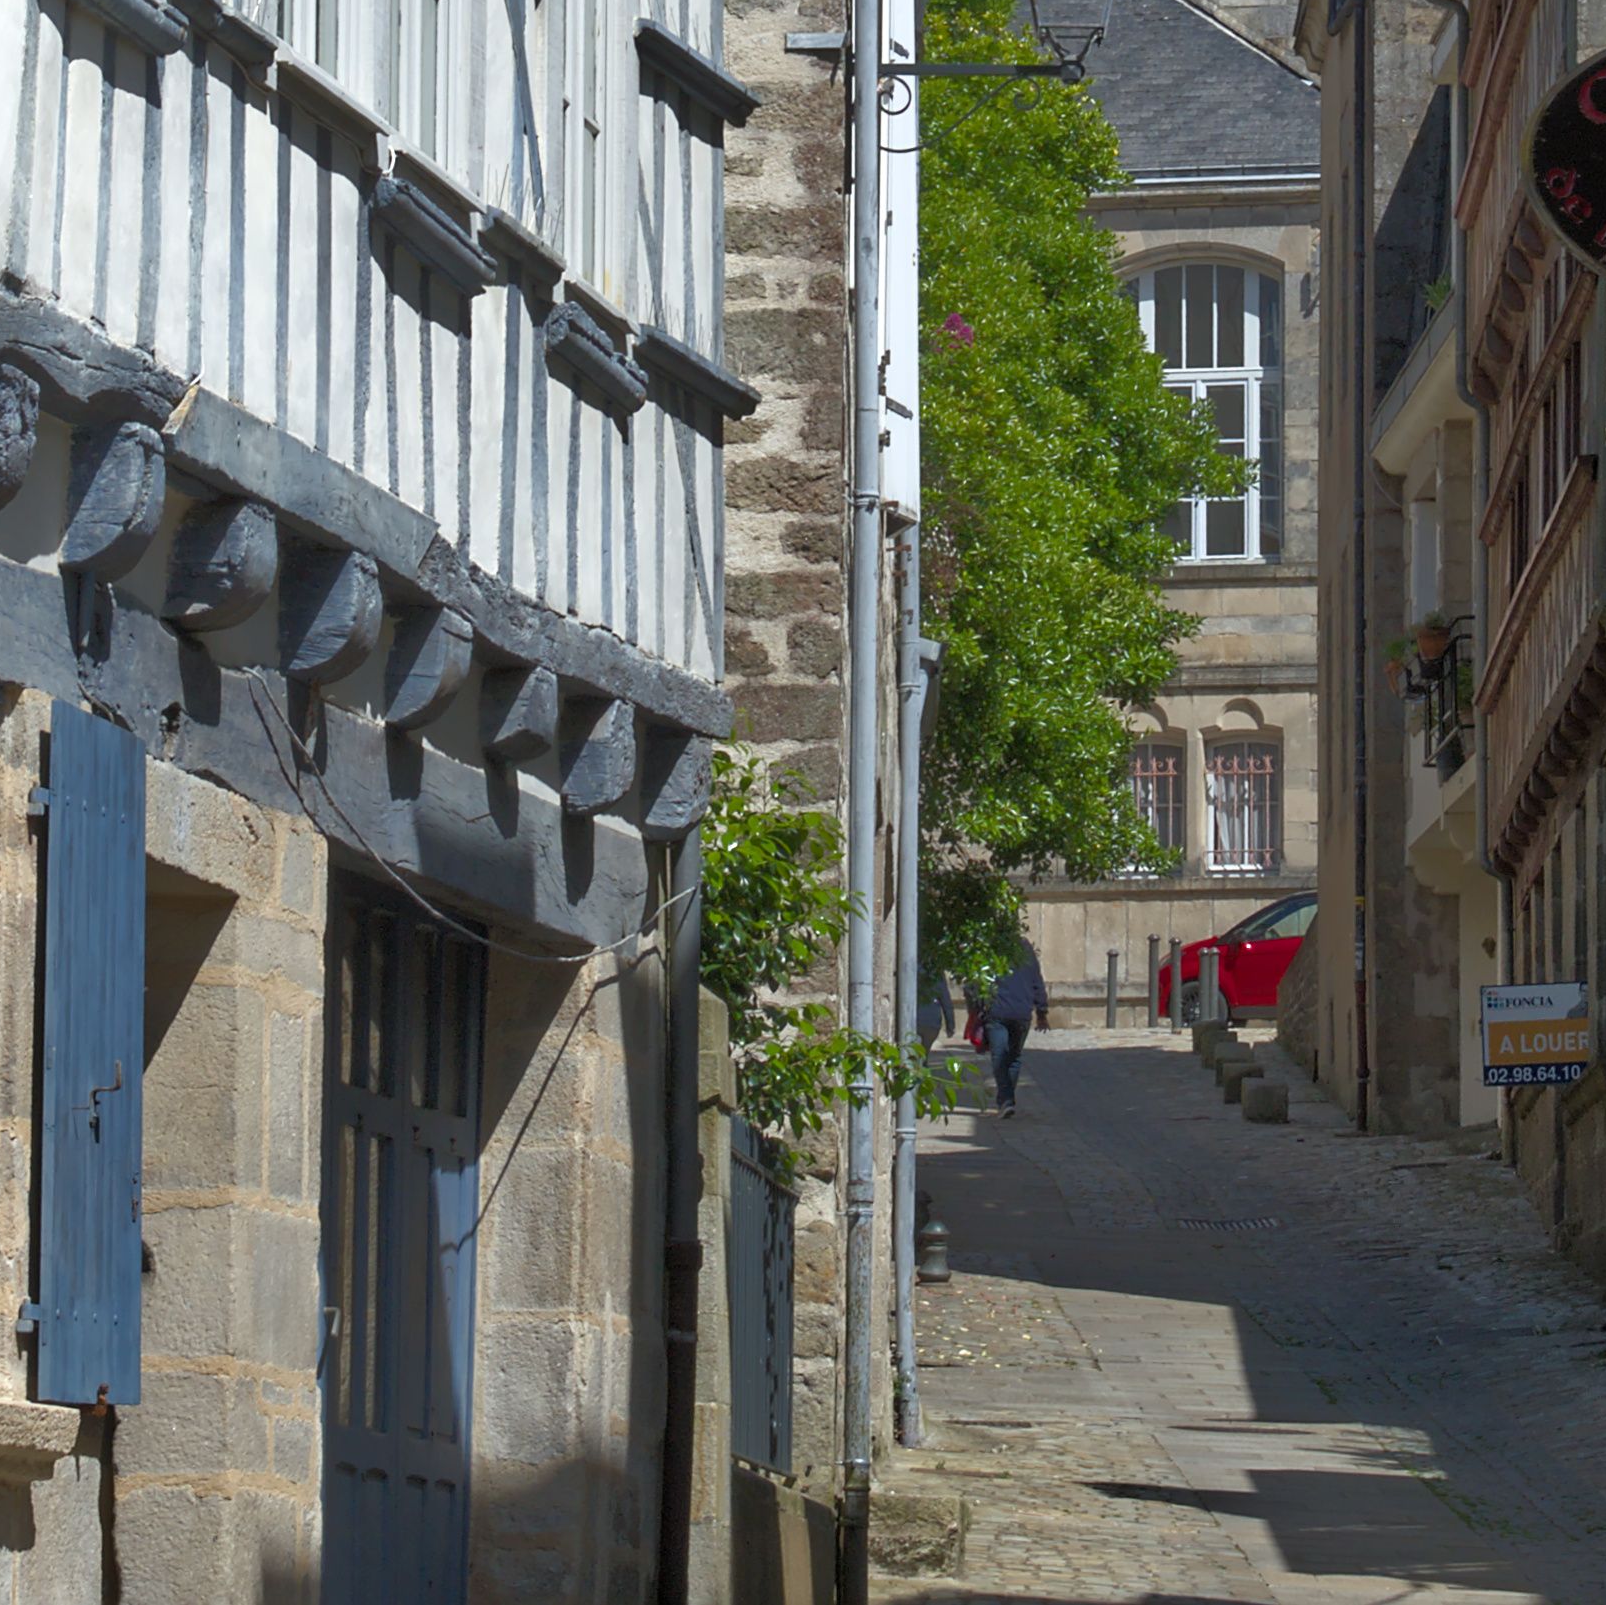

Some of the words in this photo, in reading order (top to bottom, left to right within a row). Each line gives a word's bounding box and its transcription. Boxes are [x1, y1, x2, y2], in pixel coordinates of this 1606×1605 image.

[1545, 167, 1593, 224] de
[1505, 996, 1553, 1008] FONCIA
[1500, 1036, 1514, 1054] A
